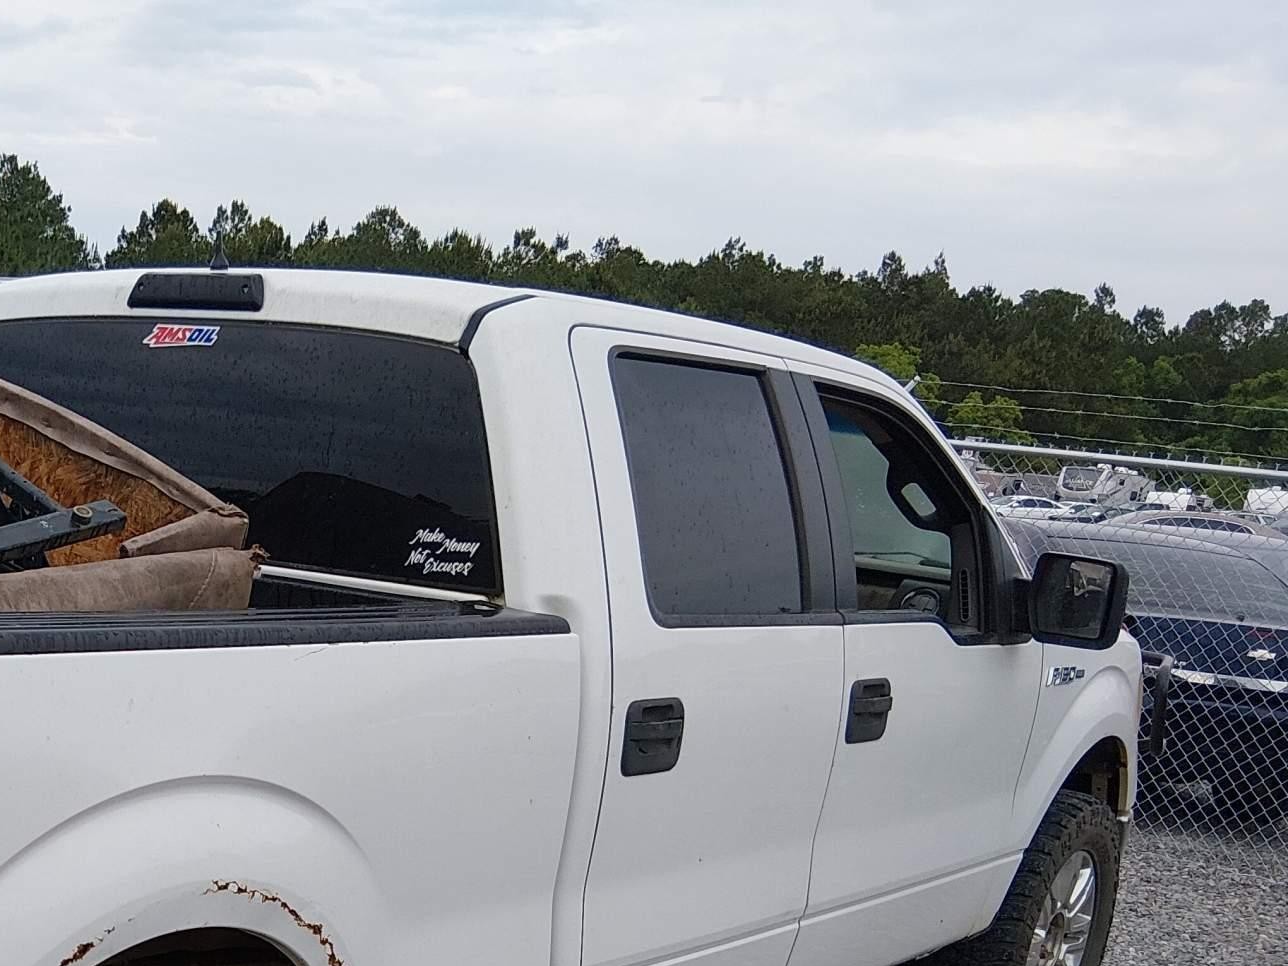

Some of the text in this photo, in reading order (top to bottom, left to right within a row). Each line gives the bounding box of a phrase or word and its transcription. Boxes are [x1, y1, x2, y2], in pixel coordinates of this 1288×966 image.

[143, 325, 220, 346] AMSOIL
[408, 527, 480, 558] Make Money
[404, 547, 473, 576] Not Excuses
